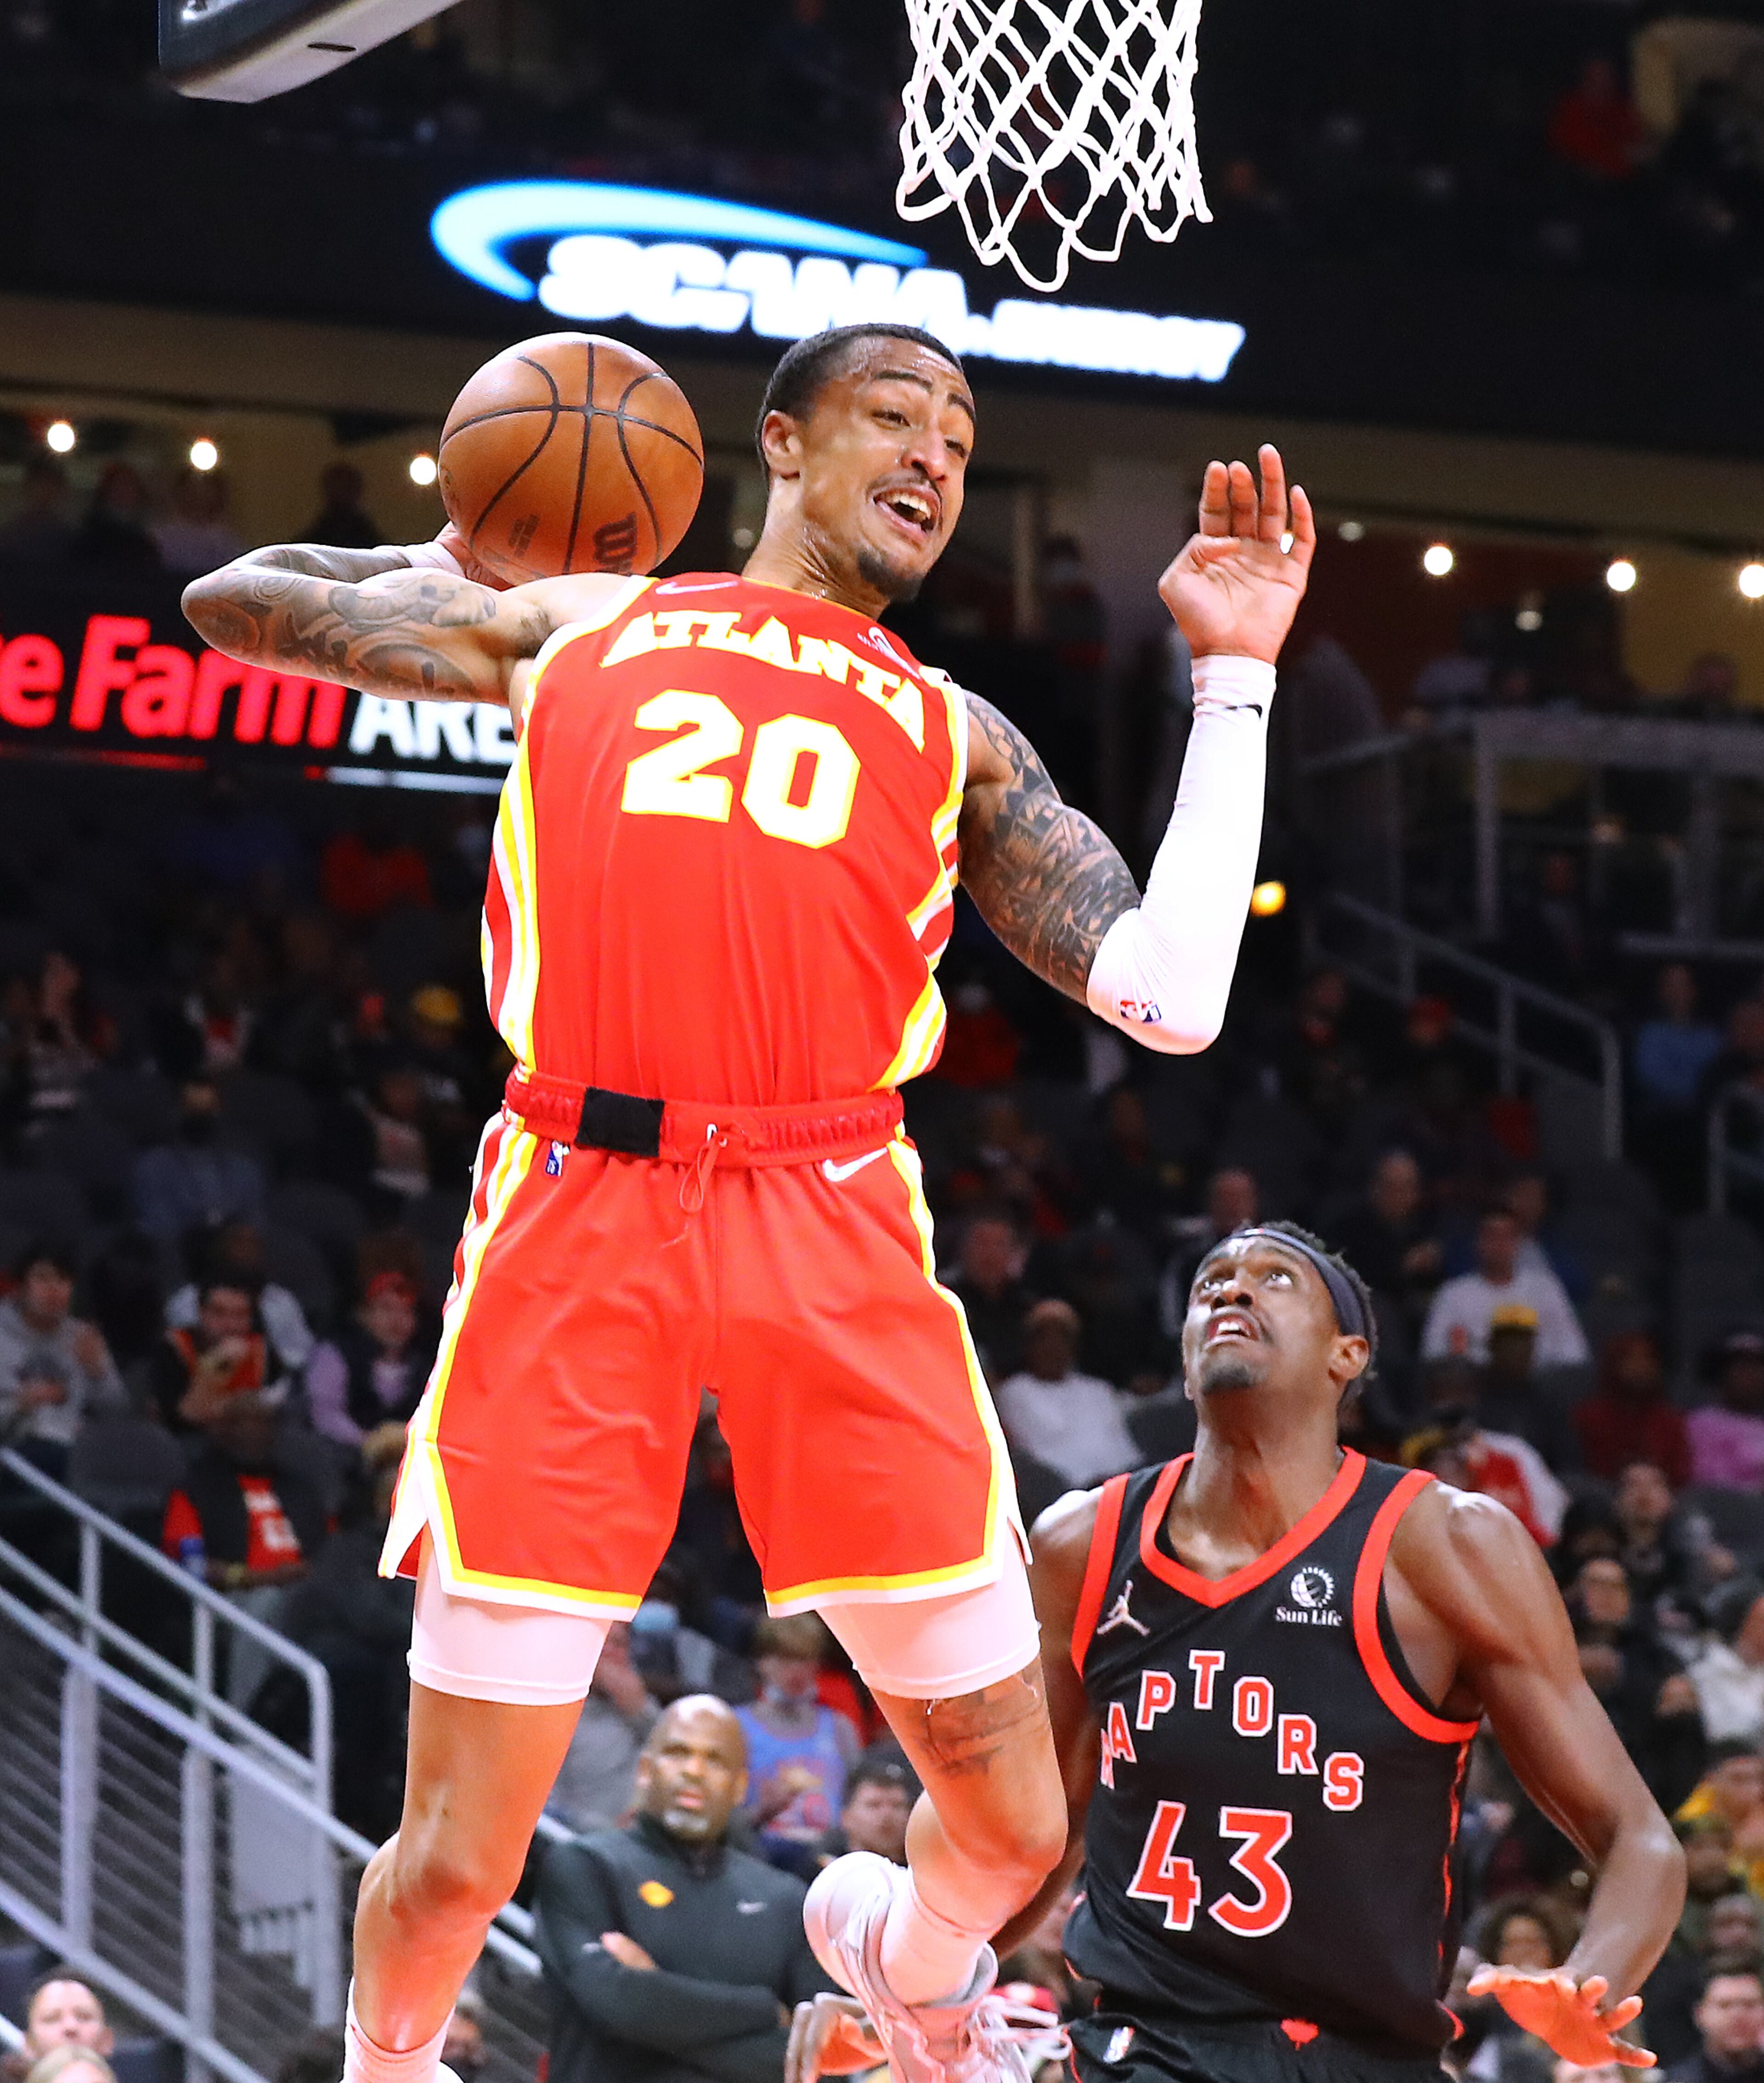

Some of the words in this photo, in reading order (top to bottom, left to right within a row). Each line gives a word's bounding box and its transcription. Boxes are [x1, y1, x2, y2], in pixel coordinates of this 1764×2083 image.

[69, 614, 346, 748] Farm
[347, 692, 518, 764] ARE
[599, 610, 925, 754] ATLANTA
[621, 688, 861, 849] 20
[1274, 1606, 1308, 1624] Sun
[1312, 1609, 1342, 1627] Life
[1126, 1800, 1293, 1937] 43
